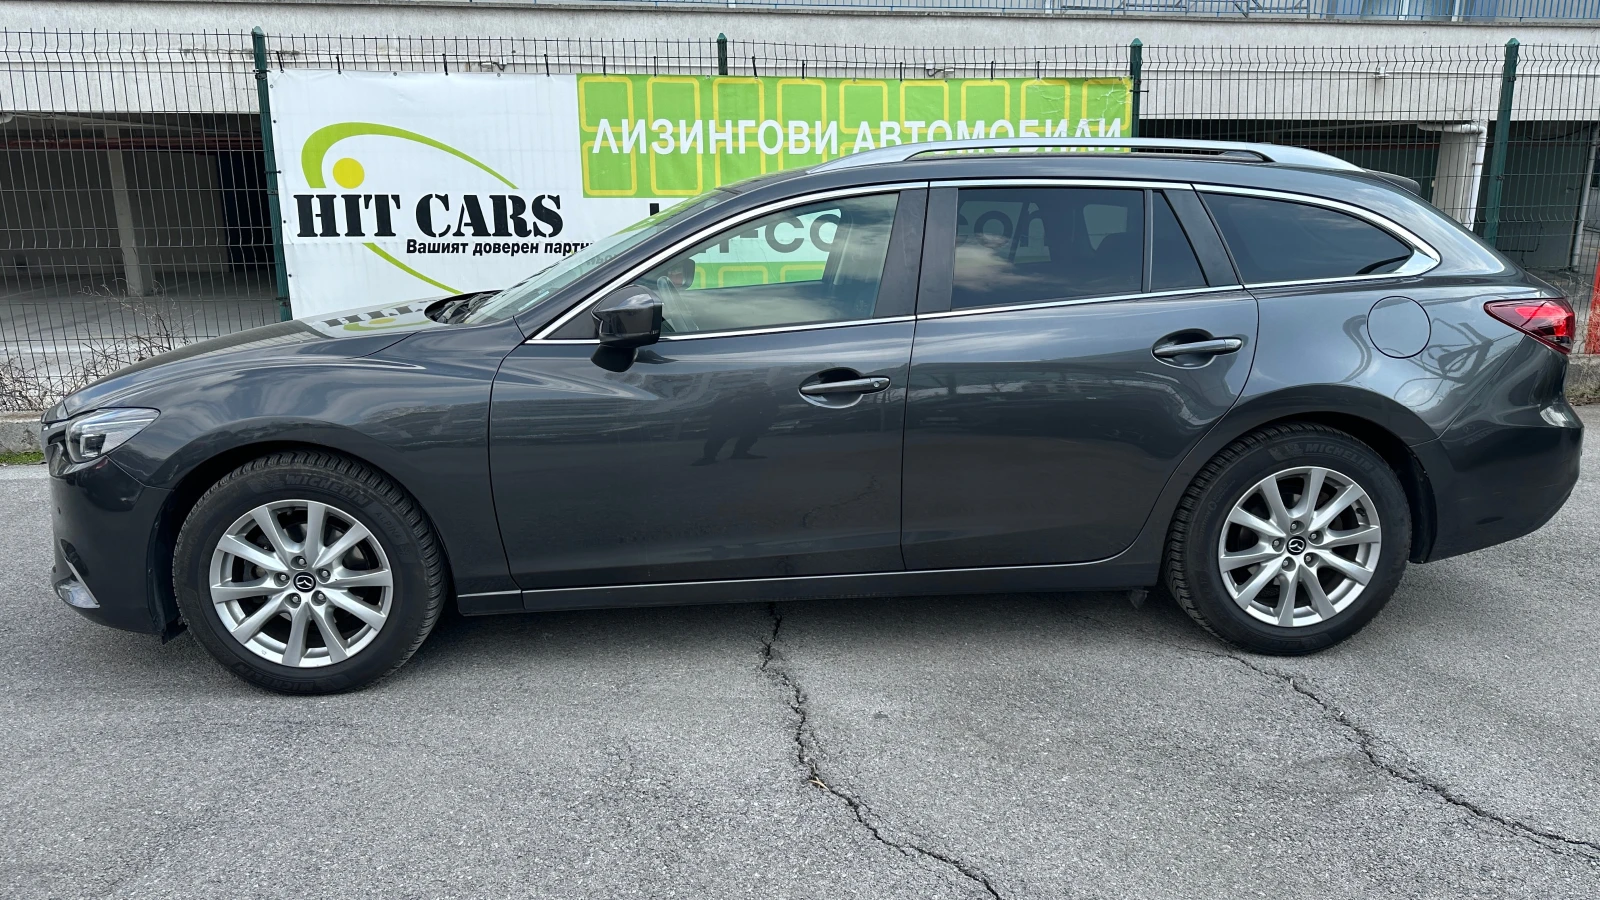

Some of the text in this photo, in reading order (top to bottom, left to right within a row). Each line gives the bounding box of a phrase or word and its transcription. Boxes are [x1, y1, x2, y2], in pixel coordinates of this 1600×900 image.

[592, 118, 839, 156] ЛИЗИНГОВИ
[293, 193, 564, 238] HIT CARS
[406, 238, 469, 254] Вашият
[472, 241, 539, 257] доверен
[1305, 443, 1374, 471] MICHELIN
[285, 473, 371, 506] MICHELIN
